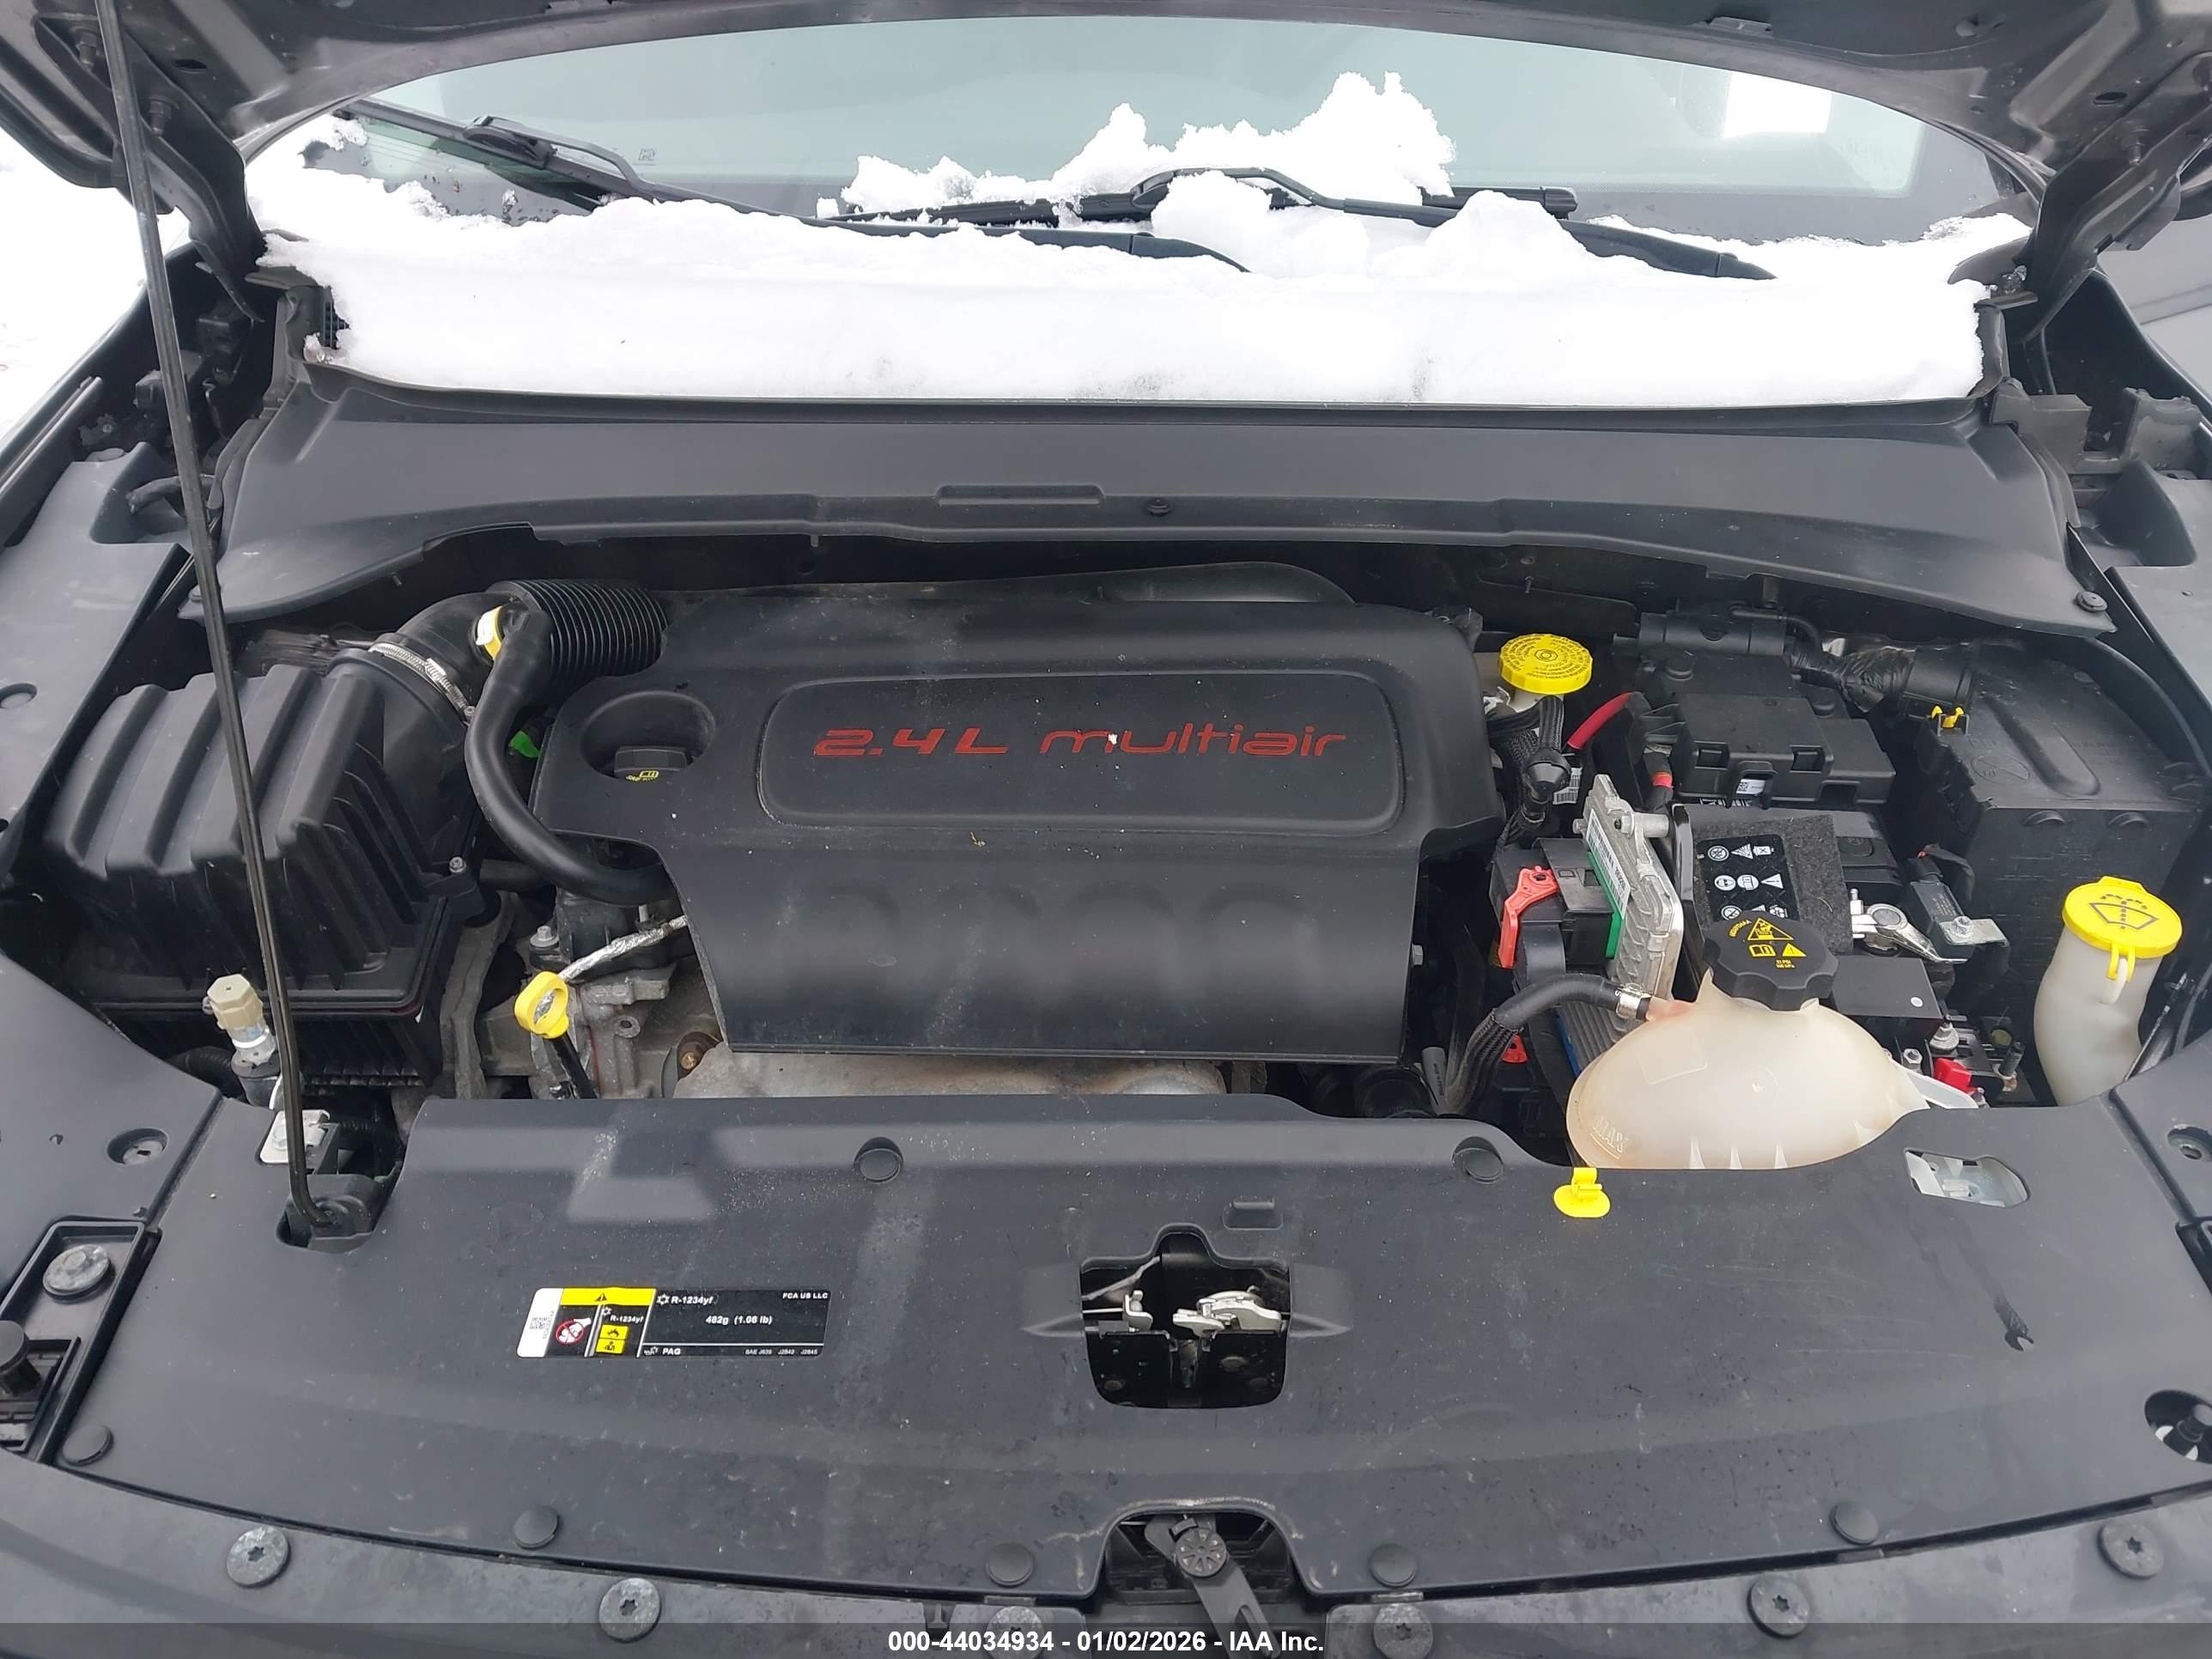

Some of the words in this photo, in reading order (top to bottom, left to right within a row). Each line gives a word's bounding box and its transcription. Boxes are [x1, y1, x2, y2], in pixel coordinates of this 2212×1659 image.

[1039, 722, 1347, 757] multiair
[671, 1296, 713, 1305] R-1234yf
[611, 1316, 644, 1324] R-1234yf
[760, 1316, 773, 1325] lb)
